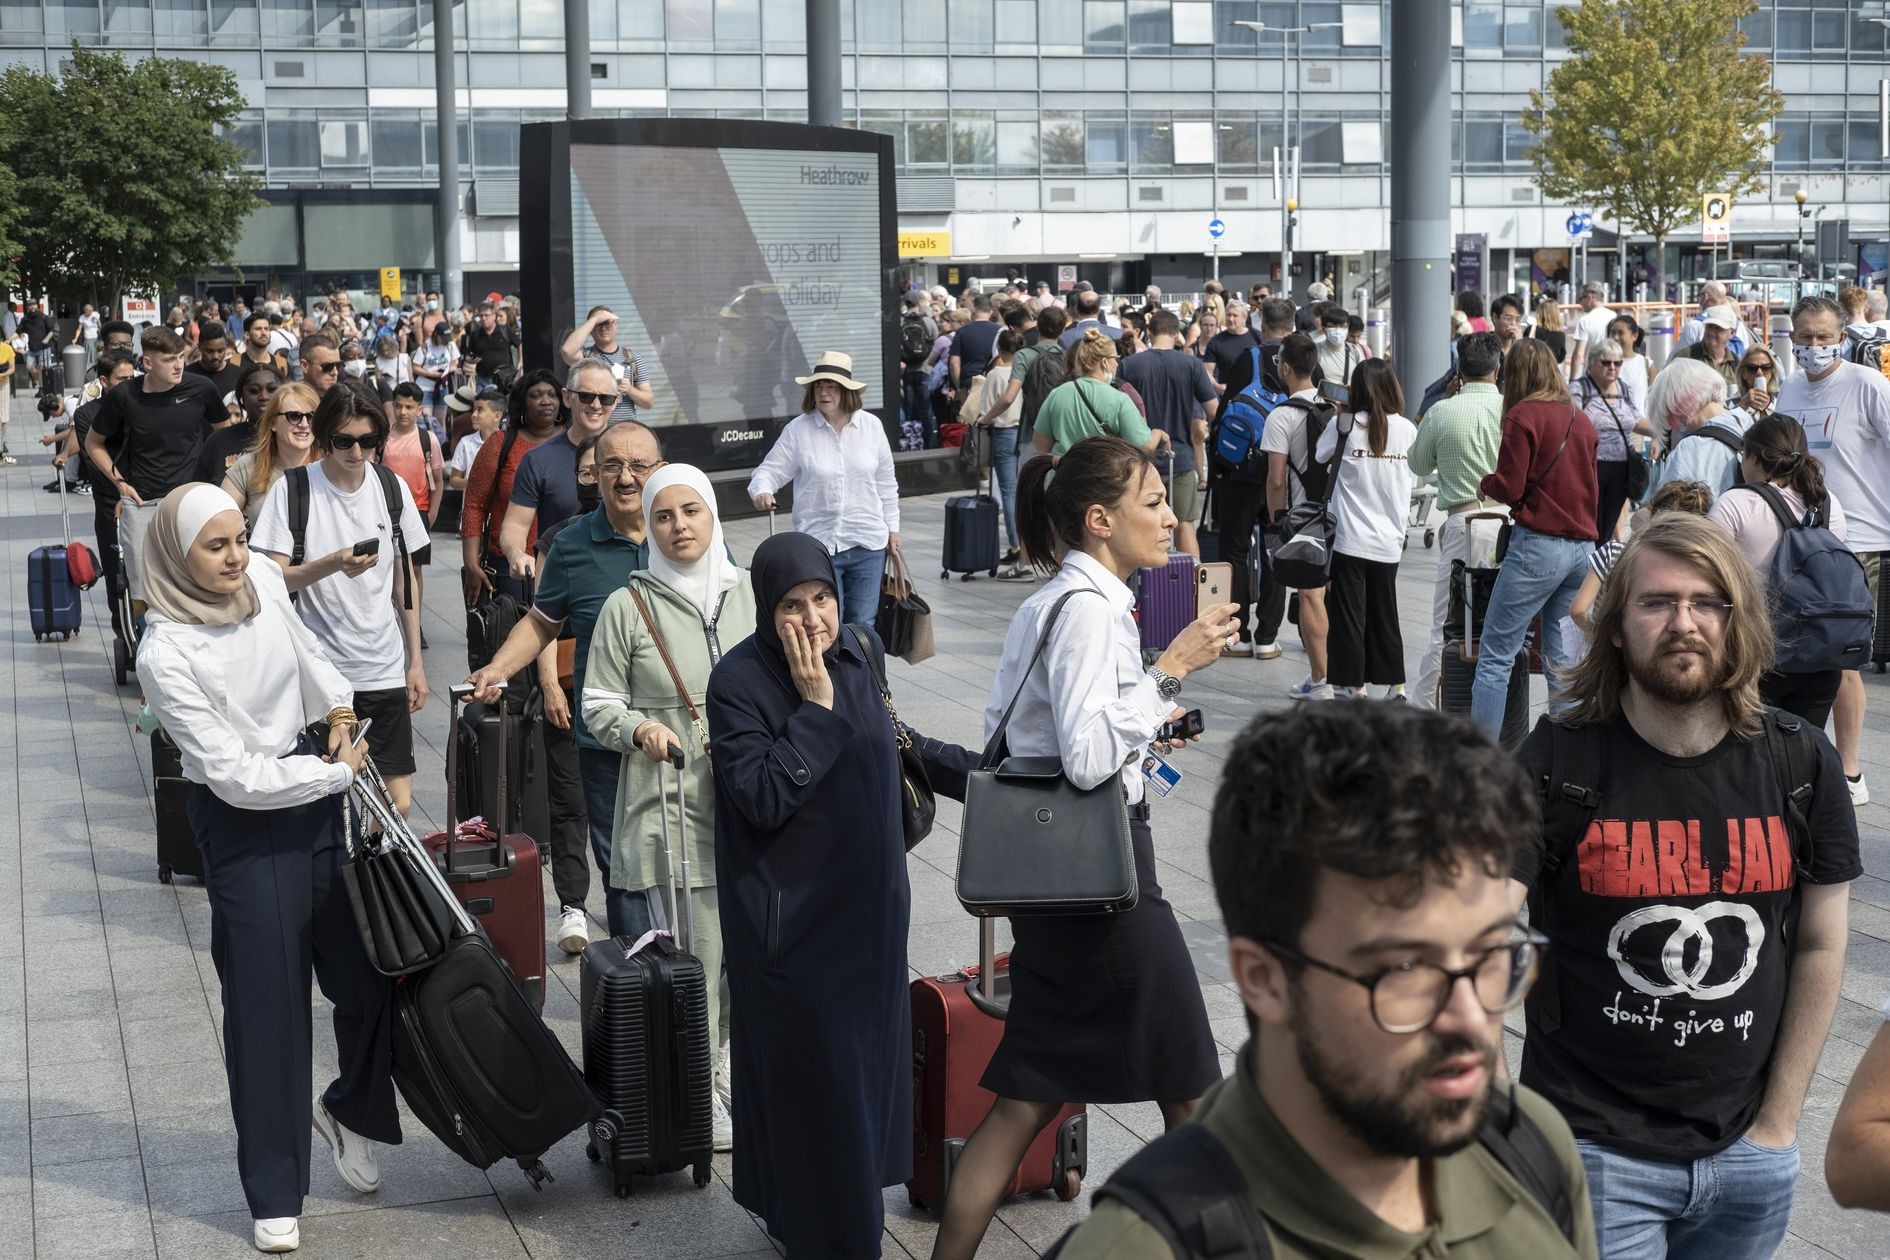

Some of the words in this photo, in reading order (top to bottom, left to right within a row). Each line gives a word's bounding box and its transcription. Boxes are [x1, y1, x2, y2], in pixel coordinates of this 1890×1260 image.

[800, 165, 870, 186] Heathrow
[806, 232, 841, 263] and
[720, 430, 764, 442] JCDecaux
[1577, 819, 1710, 897] PEARL
[1721, 815, 1793, 895] JAM
[1602, 991, 1663, 1031] don't
[1674, 1010, 1724, 1047] give
[1734, 1010, 1753, 1041] up
